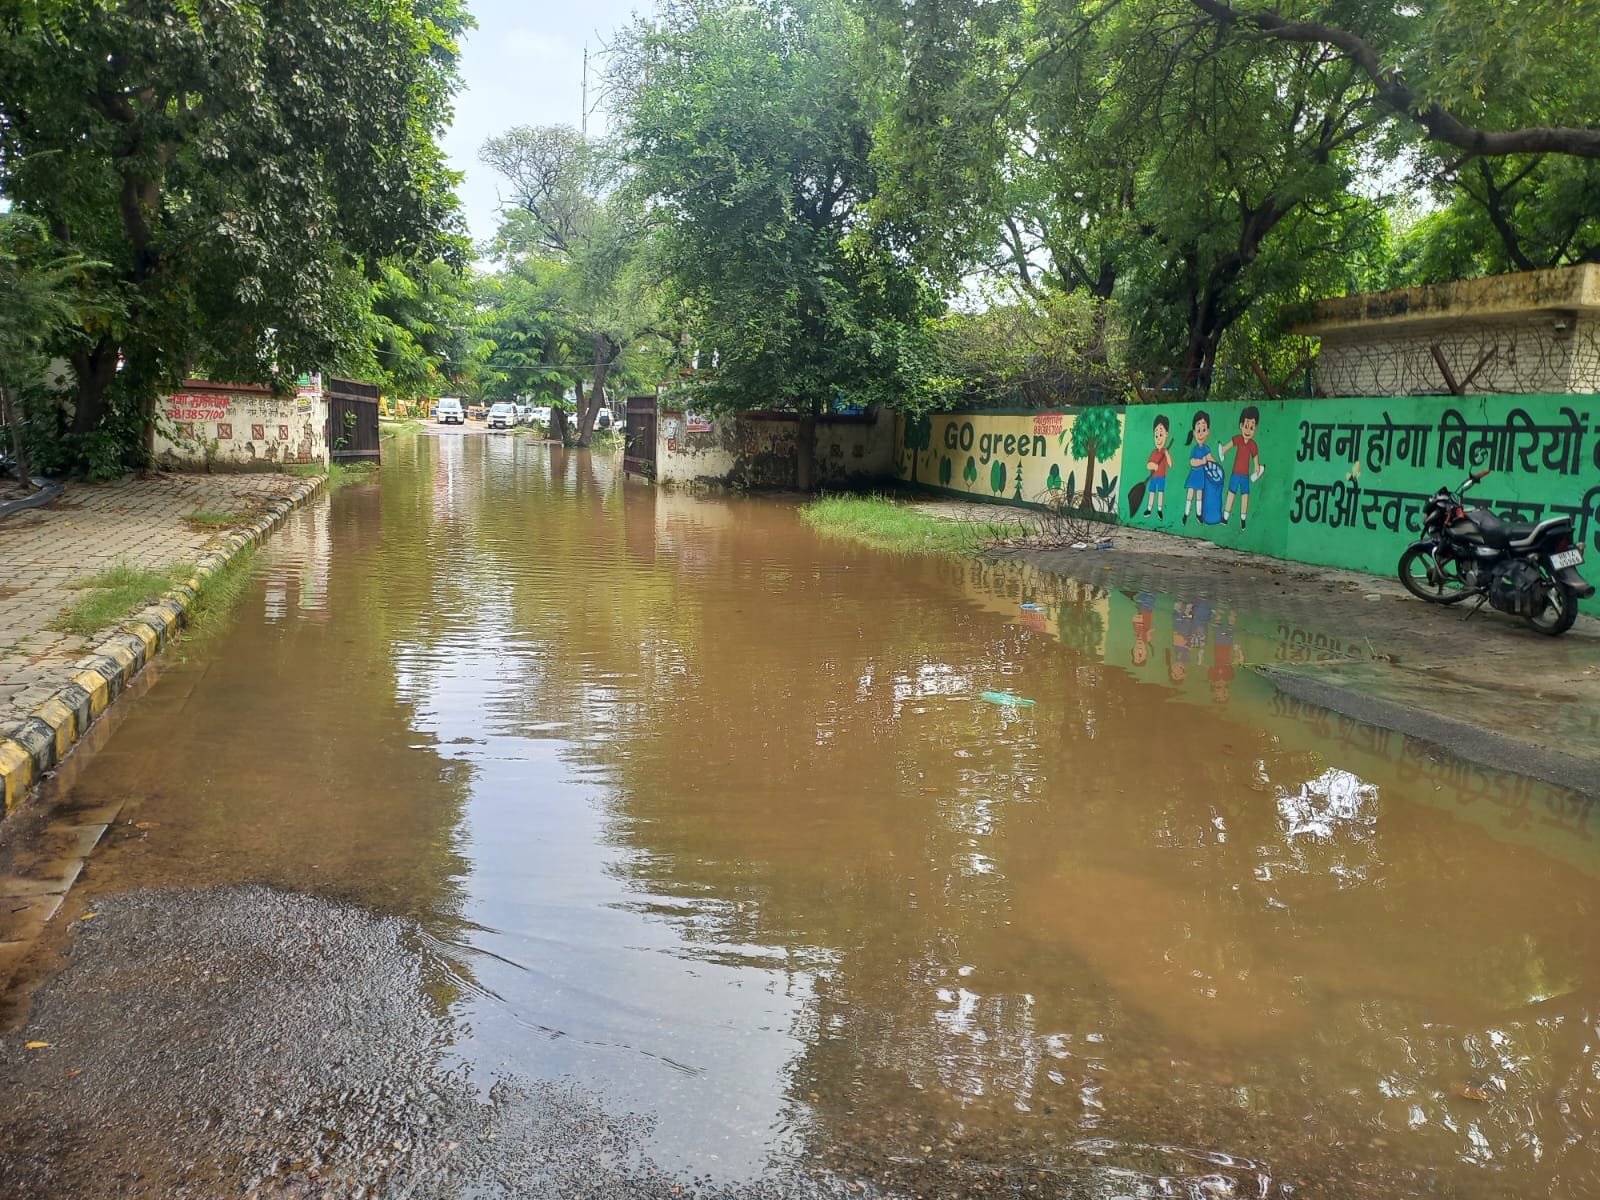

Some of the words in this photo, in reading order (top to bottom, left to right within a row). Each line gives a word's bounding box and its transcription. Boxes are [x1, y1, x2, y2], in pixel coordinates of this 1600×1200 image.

[944, 422, 974, 451] GO
[980, 433, 1047, 465] green
[1366, 411, 1433, 473] होगा
[1437, 407, 1590, 475] बिमारियों
[1289, 474, 1361, 528] उठाओ
